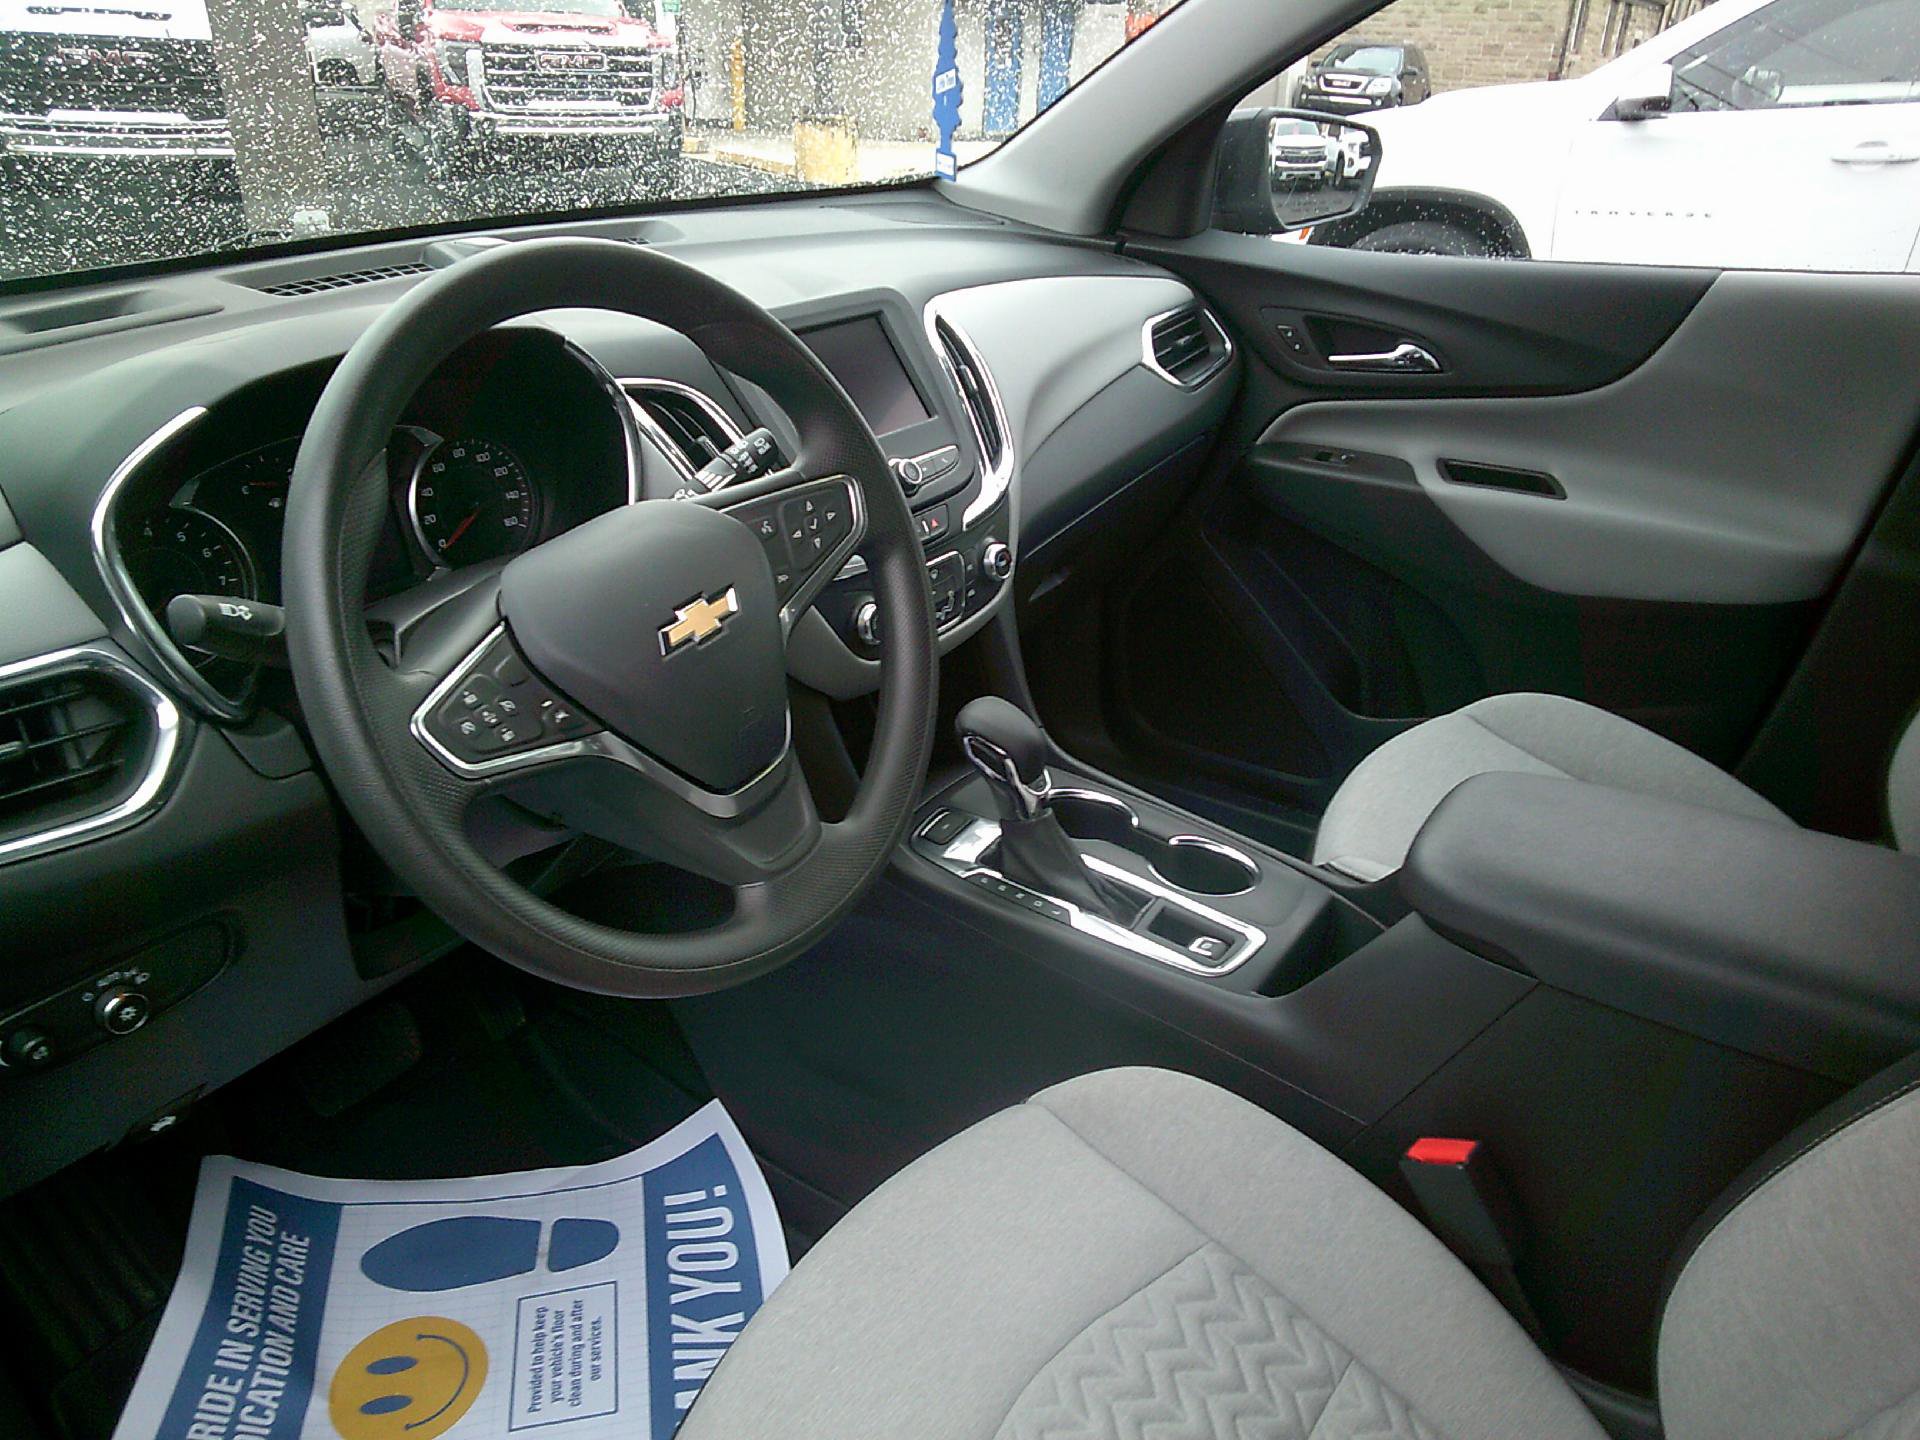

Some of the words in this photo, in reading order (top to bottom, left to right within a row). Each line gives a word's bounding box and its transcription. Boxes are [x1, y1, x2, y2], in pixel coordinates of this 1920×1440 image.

[540, 54, 603, 70] GMC
[176, 531, 187, 542] 5
[245, 1204, 278, 1246] YOU
[275, 1231, 310, 1286] CARE
[663, 1184, 744, 1305] YOU!
[227, 1245, 272, 1337] SERVING
[267, 1284, 301, 1334] AND
[532, 1307, 549, 1332] keep
[552, 1310, 565, 1333] floor
[570, 1300, 584, 1322] after
[530, 1334, 548, 1355] help
[569, 1324, 583, 1343] and
[214, 1338, 256, 1372] IN
[549, 1333, 564, 1378] vehicle's
[568, 1343, 585, 1377] during
[590, 1364, 602, 1381] our
[527, 1367, 544, 1413] Provided
[551, 1380, 565, 1403] your
[568, 1378, 582, 1407] clean
